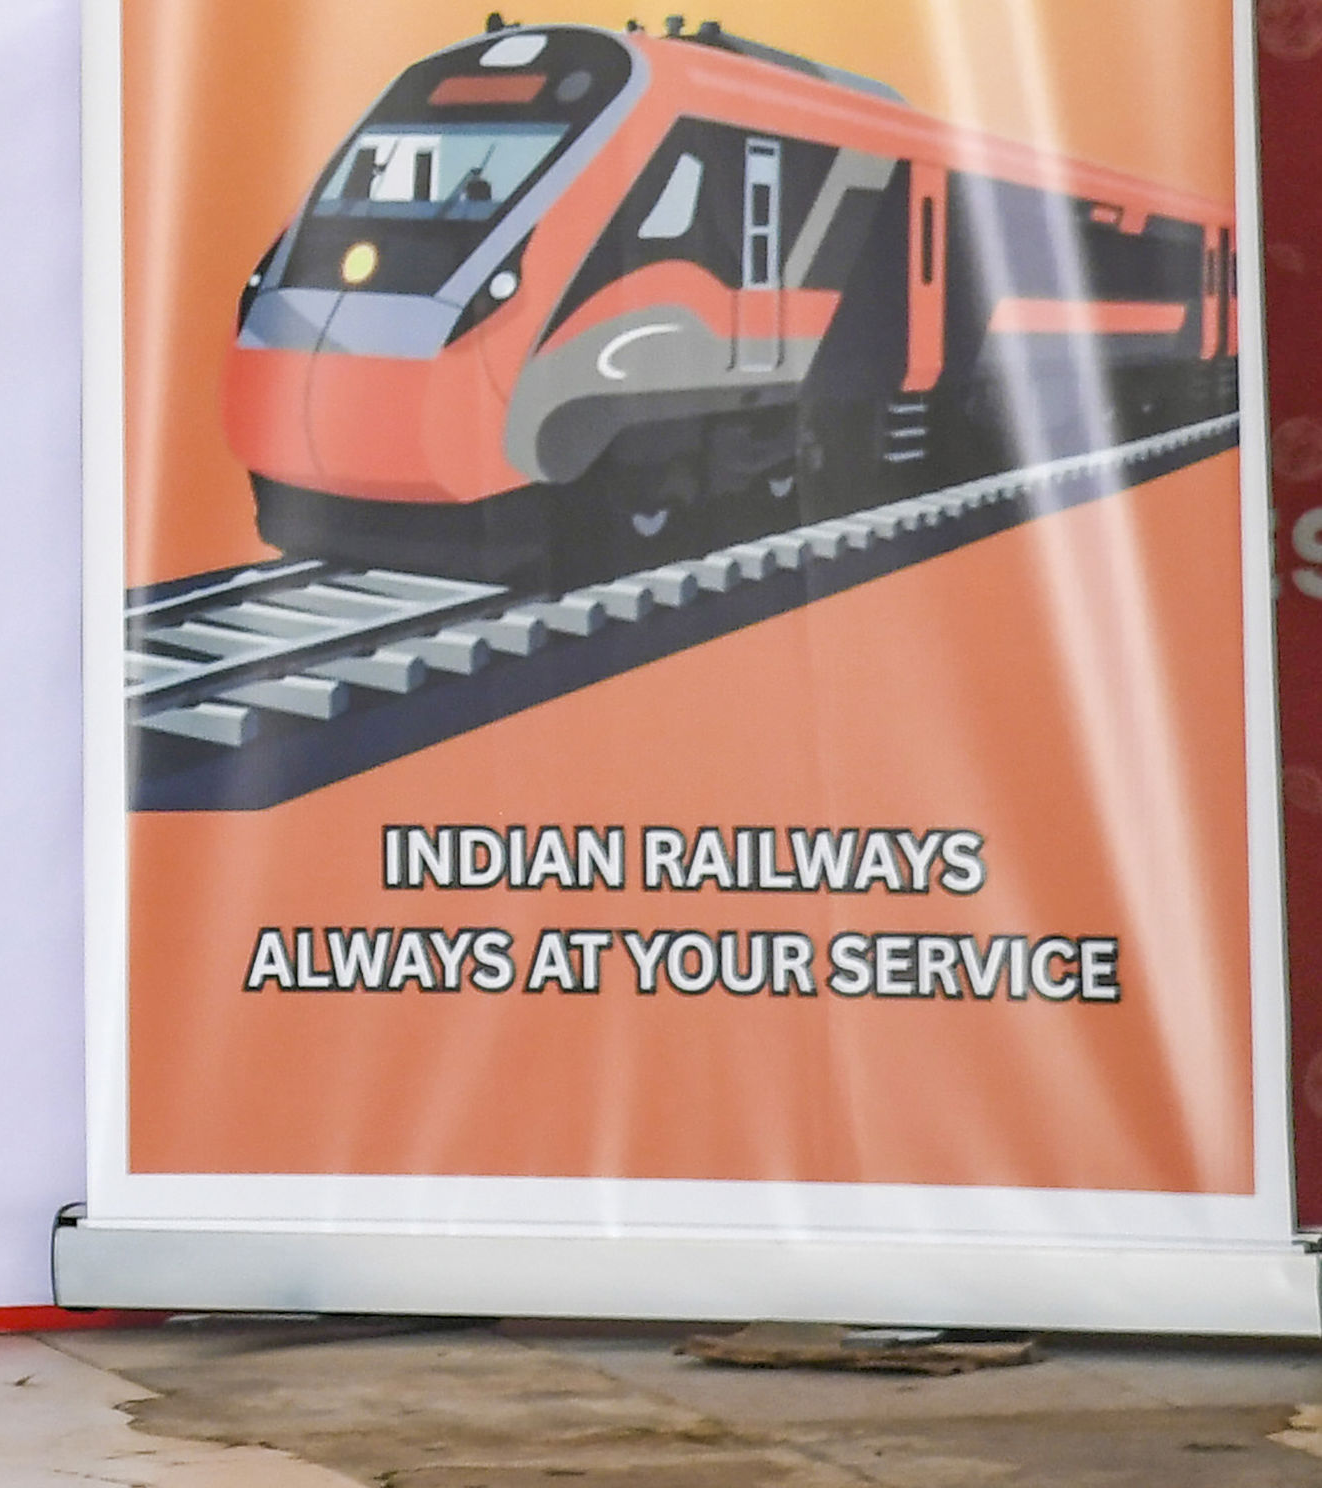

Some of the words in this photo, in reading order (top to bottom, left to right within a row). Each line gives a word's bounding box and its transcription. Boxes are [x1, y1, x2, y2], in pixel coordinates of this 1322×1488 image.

[382, 824, 624, 891] INDIAN
[642, 826, 986, 894] RAILWAYS
[243, 927, 514, 994] ALWAYS
[525, 929, 613, 995] AT
[618, 930, 816, 997] YOUR
[829, 934, 1121, 1002] SERVICE
